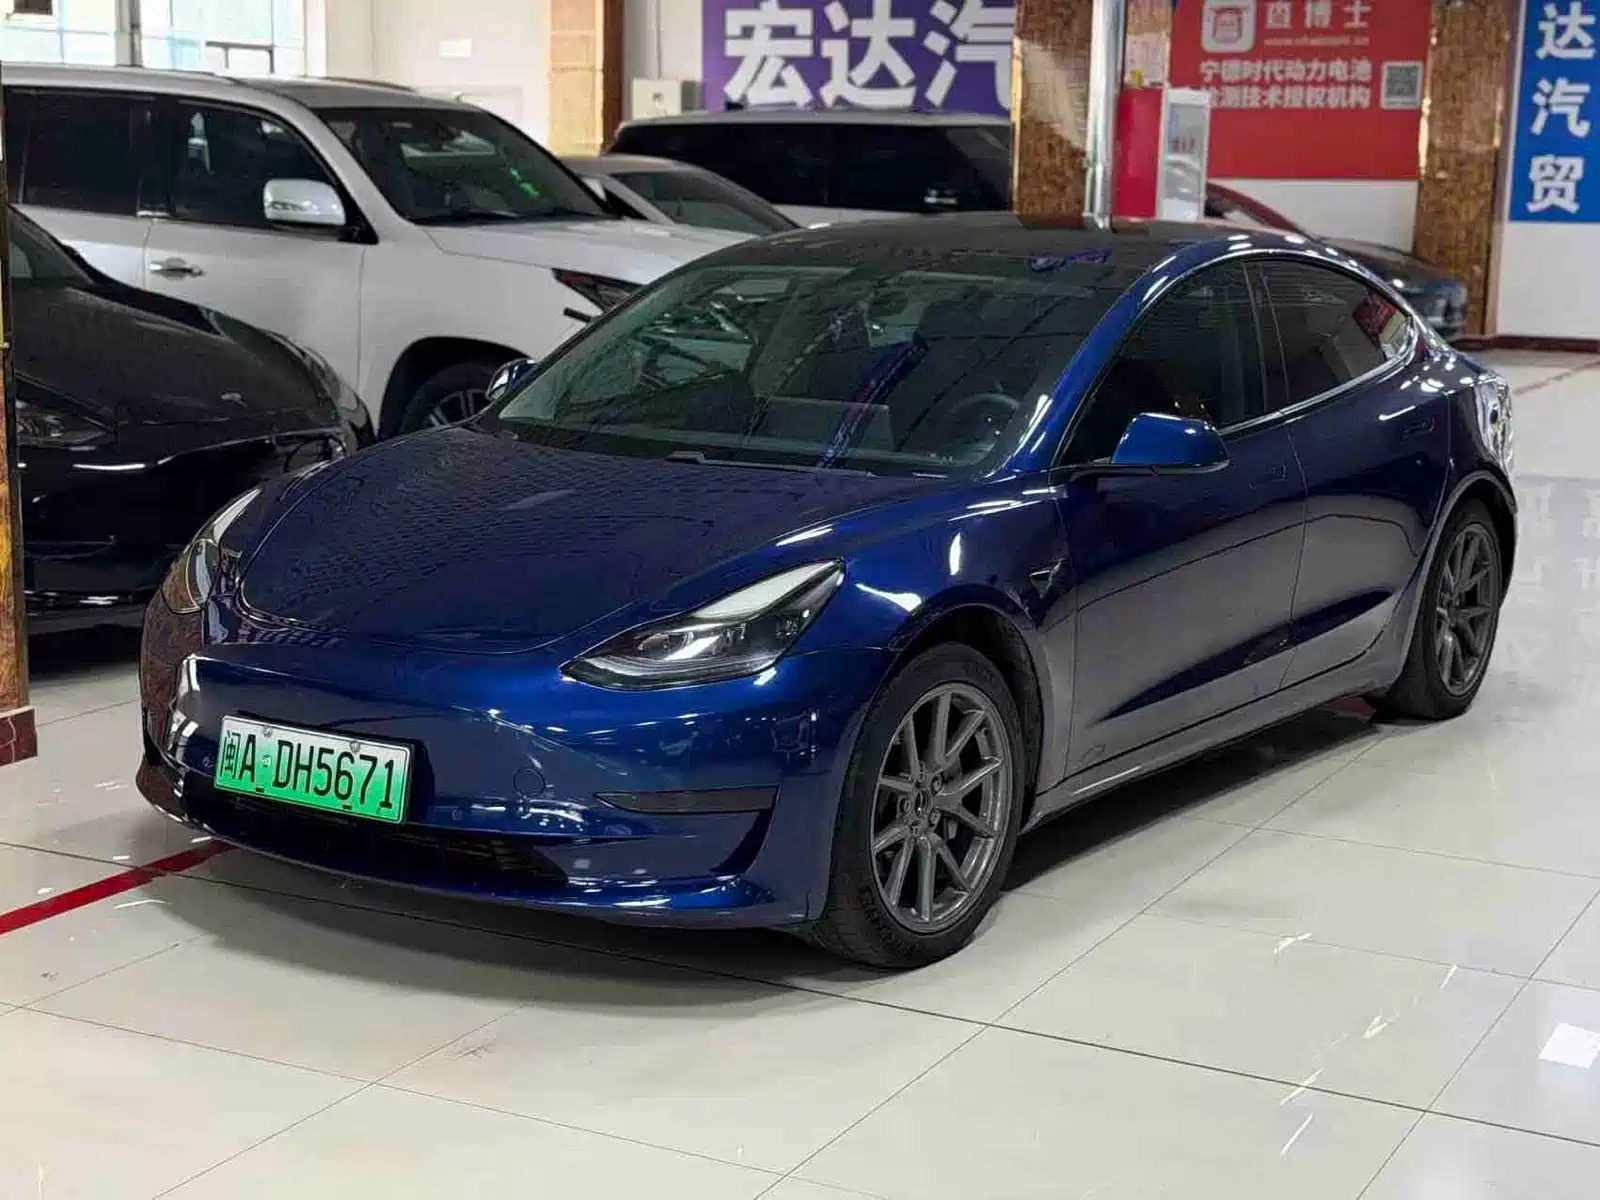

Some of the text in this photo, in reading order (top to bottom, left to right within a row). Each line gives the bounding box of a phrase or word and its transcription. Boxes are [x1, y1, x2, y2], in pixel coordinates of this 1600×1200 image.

[724, 0, 1013, 108] 宏达汽
[1526, 1, 1596, 213] 达汽贸
